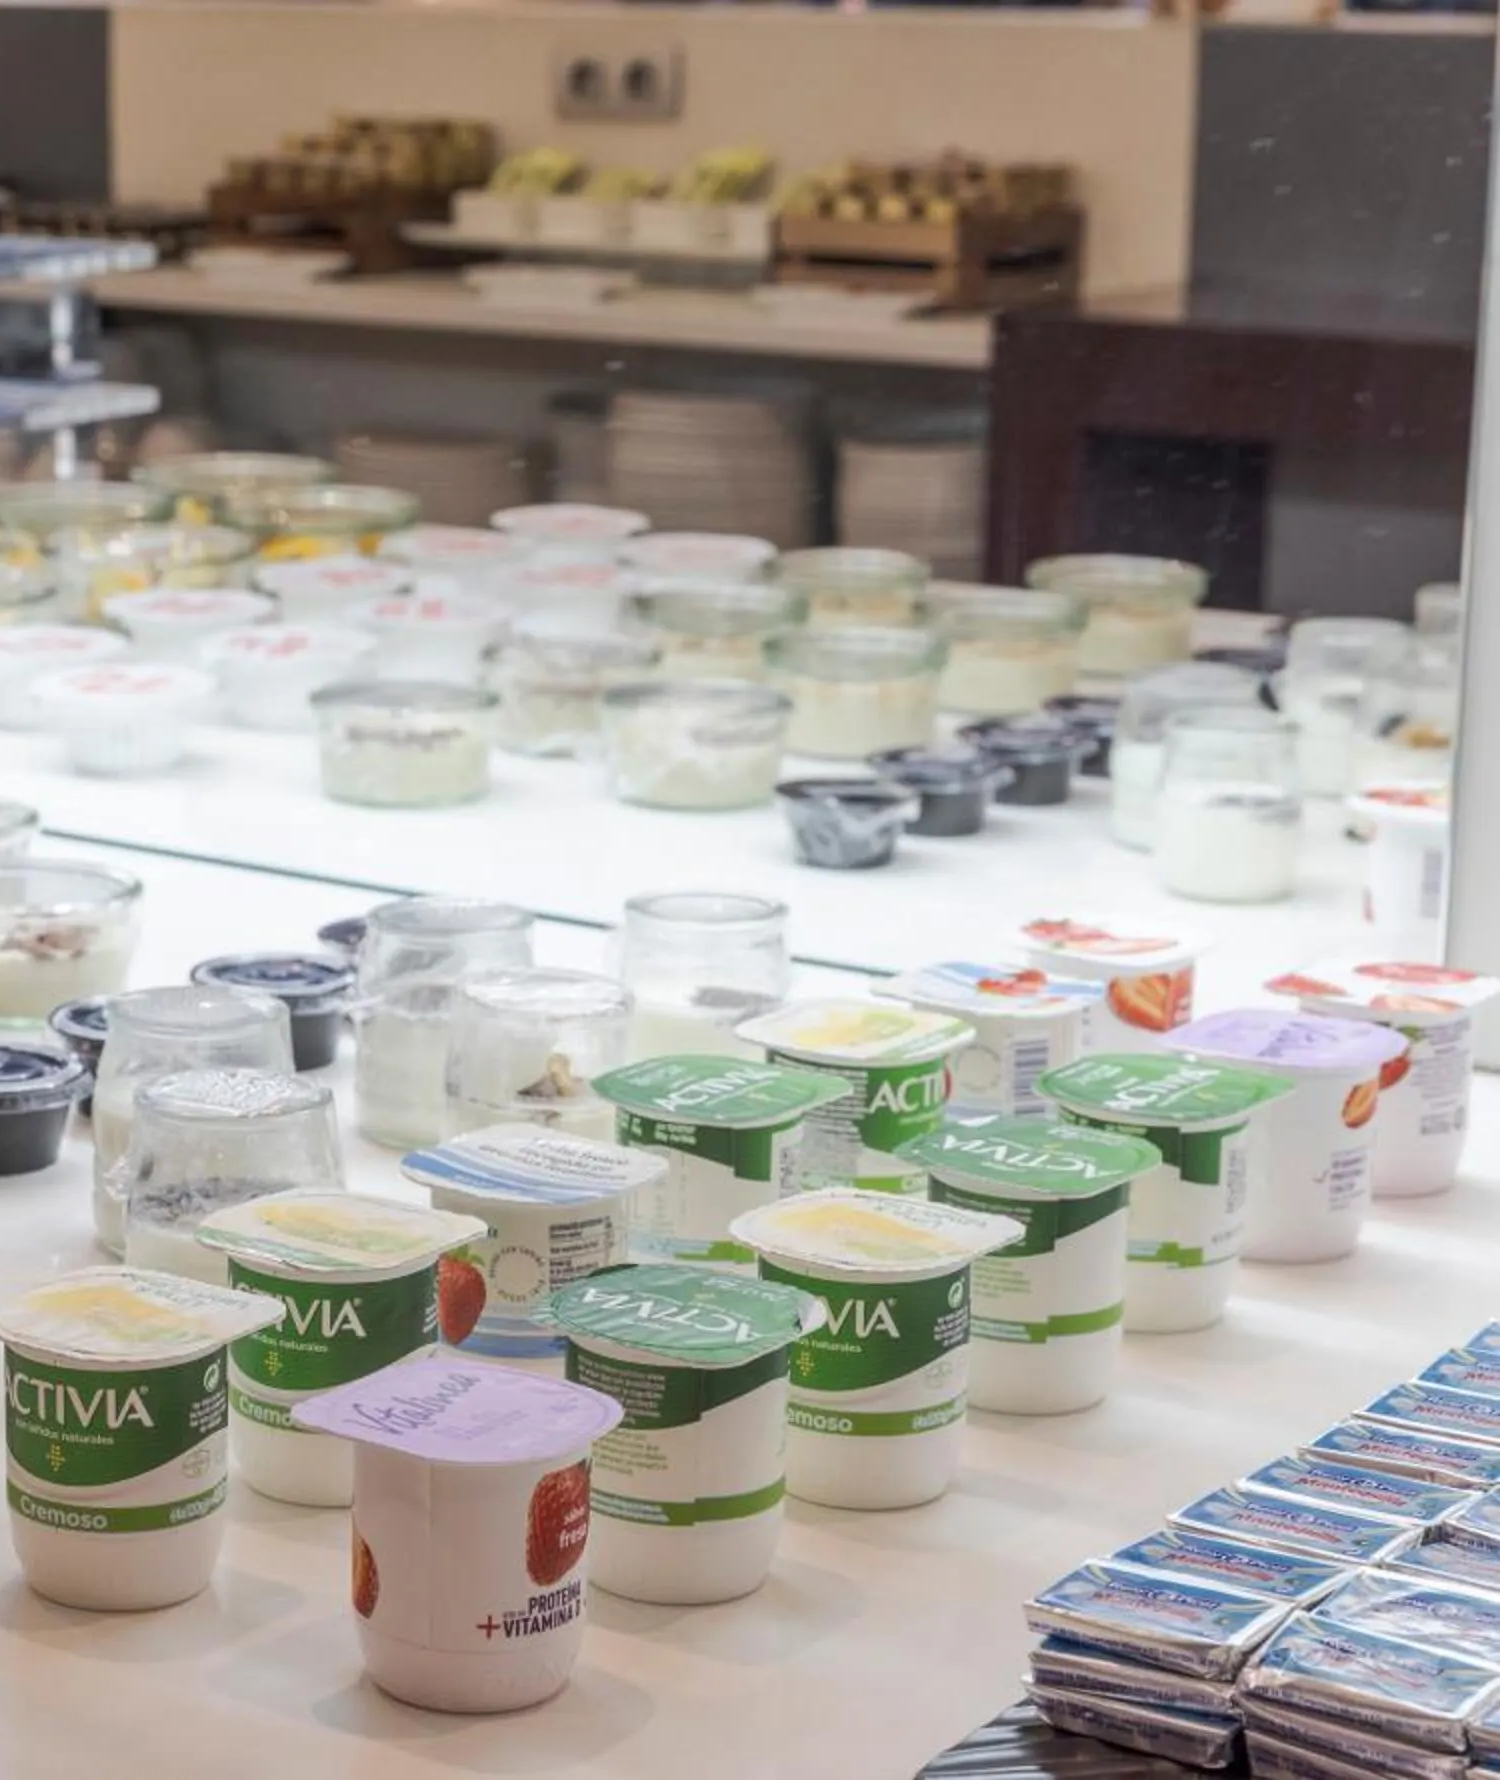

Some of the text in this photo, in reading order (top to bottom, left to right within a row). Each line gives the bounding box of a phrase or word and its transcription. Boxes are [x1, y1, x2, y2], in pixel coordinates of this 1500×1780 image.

[869, 1074, 941, 1114] ACTI
[943, 1134, 1124, 1179] ACTIVIA
[582, 1287, 762, 1344] ACTIVIA
[238, 1396, 292, 1429] Cremo
[788, 1407, 854, 1434] emoso
[19, 1493, 108, 1531] Cremoso
